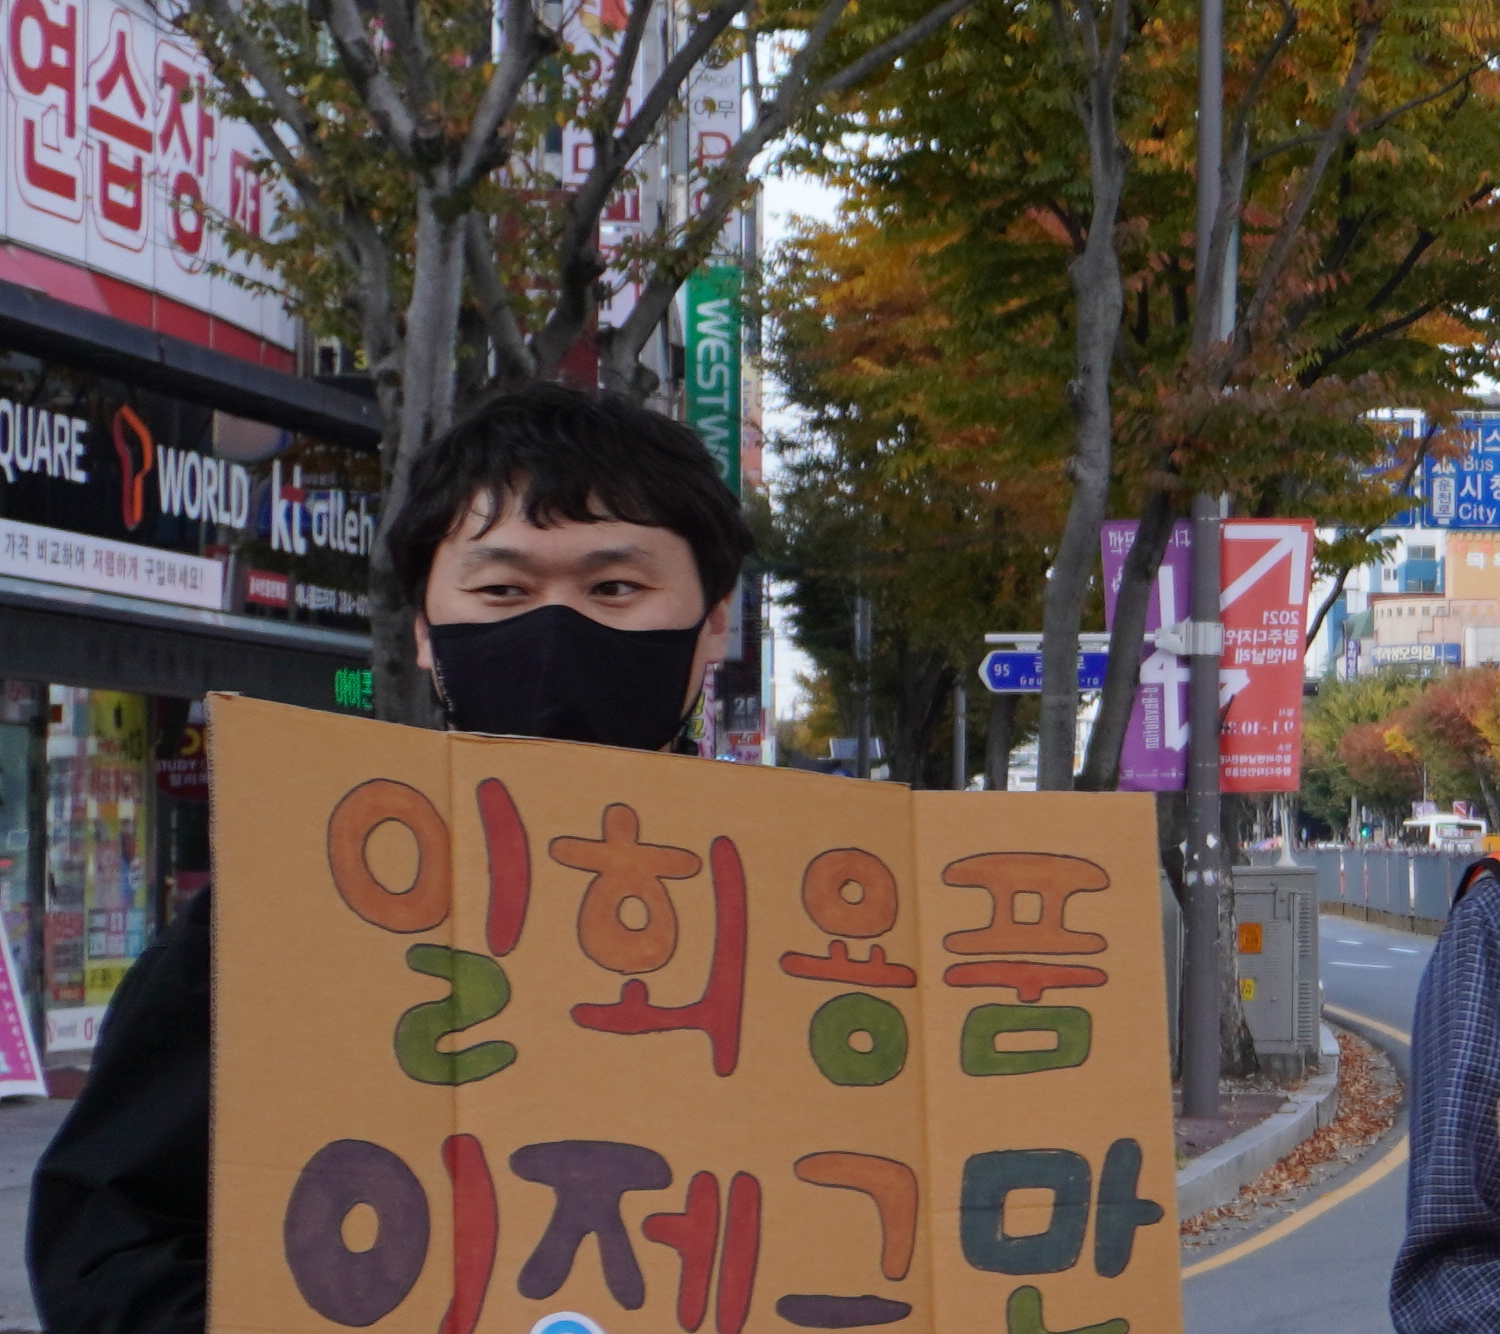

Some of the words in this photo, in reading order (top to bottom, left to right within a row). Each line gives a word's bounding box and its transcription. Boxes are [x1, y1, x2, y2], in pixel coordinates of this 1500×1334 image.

[697, 299, 730, 413] WEST
[157, 444, 250, 530] WORLD
[271, 458, 307, 555] kt
[1458, 504, 1496, 523] City
[326, 777, 1111, 1086] 일회용품
